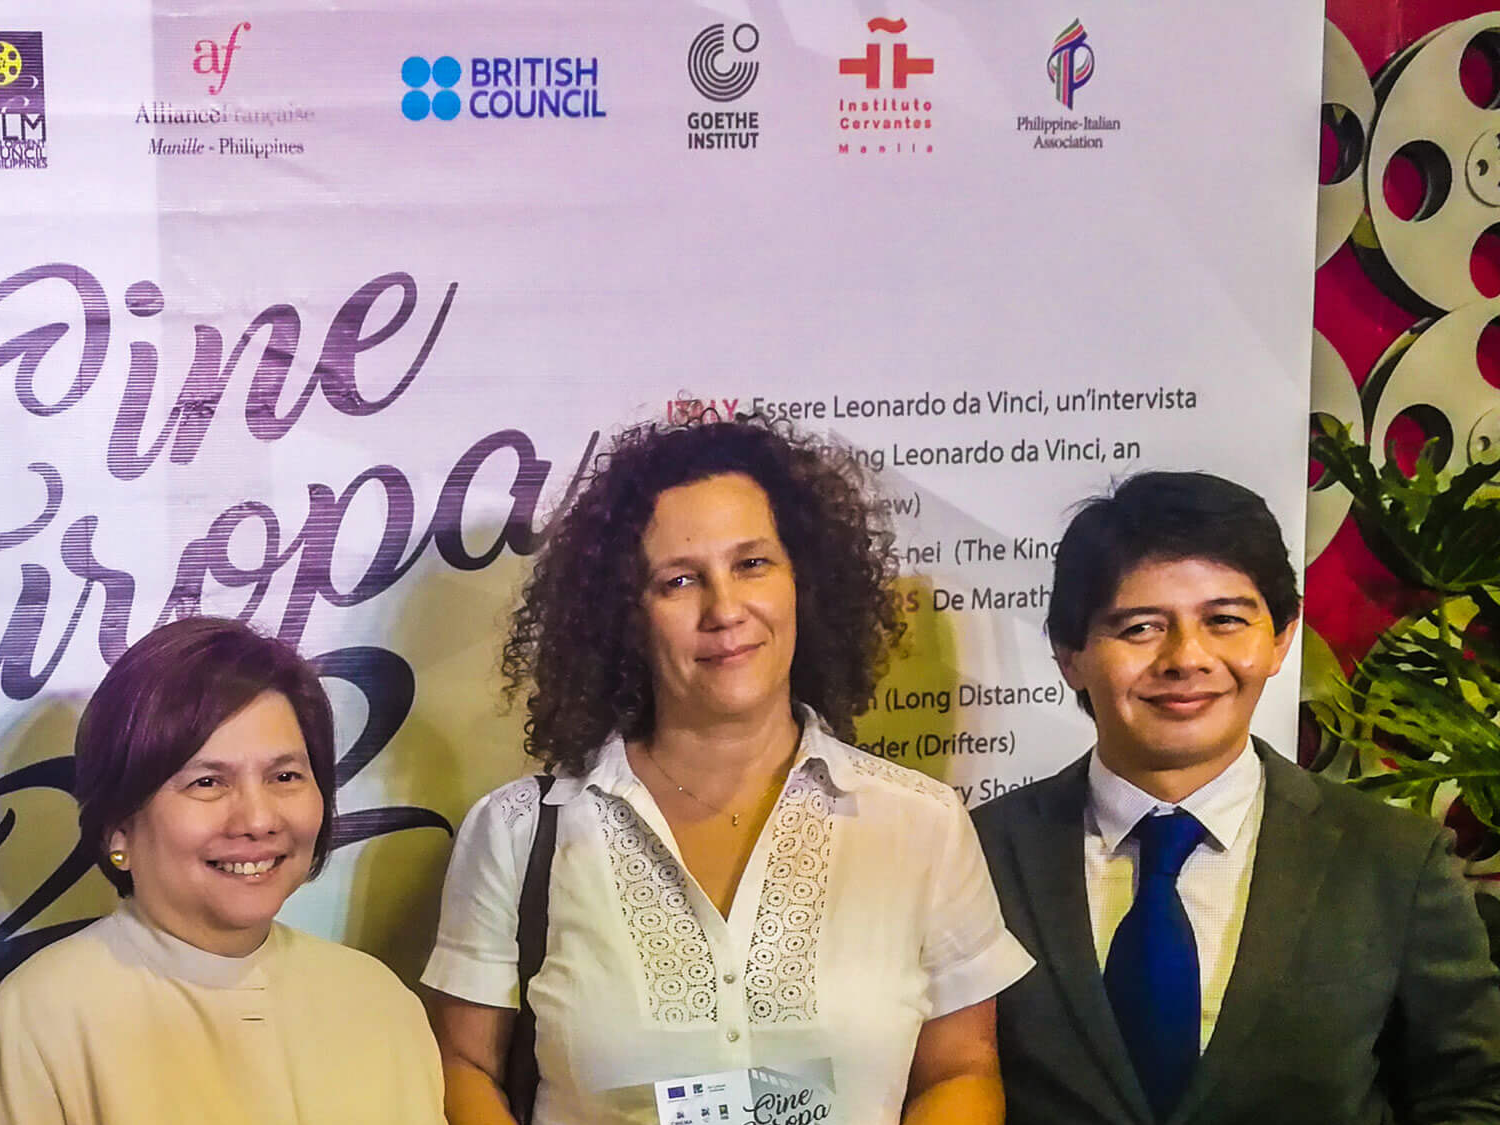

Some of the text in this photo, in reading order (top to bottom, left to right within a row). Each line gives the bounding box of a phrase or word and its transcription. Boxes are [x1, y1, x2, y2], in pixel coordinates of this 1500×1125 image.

[193, 22, 251, 95] af
[471, 57, 598, 87] BRITISH
[469, 89, 607, 119] COUNCIL
[839, 98, 932, 111] Instituto
[688, 112, 759, 129] GOETHE
[839, 117, 932, 130] Cervantes
[1017, 116, 1121, 135] Philippine-Italian
[148, 138, 205, 155] Manille
[219, 138, 305, 159] Philippines
[688, 132, 759, 149] INSTITUT
[1033, 135, 1104, 149] Association
[834, 392, 948, 418] Leonardo
[953, 391, 981, 415] da
[987, 390, 1050, 418] Vinci,
[893, 440, 1004, 465] Leonardo
[1011, 439, 1039, 462] da
[1045, 437, 1106, 463] Vinci,
[1112, 441, 1141, 460] an
[955, 538, 1005, 565] (The
[934, 589, 964, 611] De
[886, 687, 950, 713] (Long
[959, 681, 1065, 707] Distance)
[916, 731, 1015, 759] (Drifters)
[743, 1088, 814, 1125] Cine
